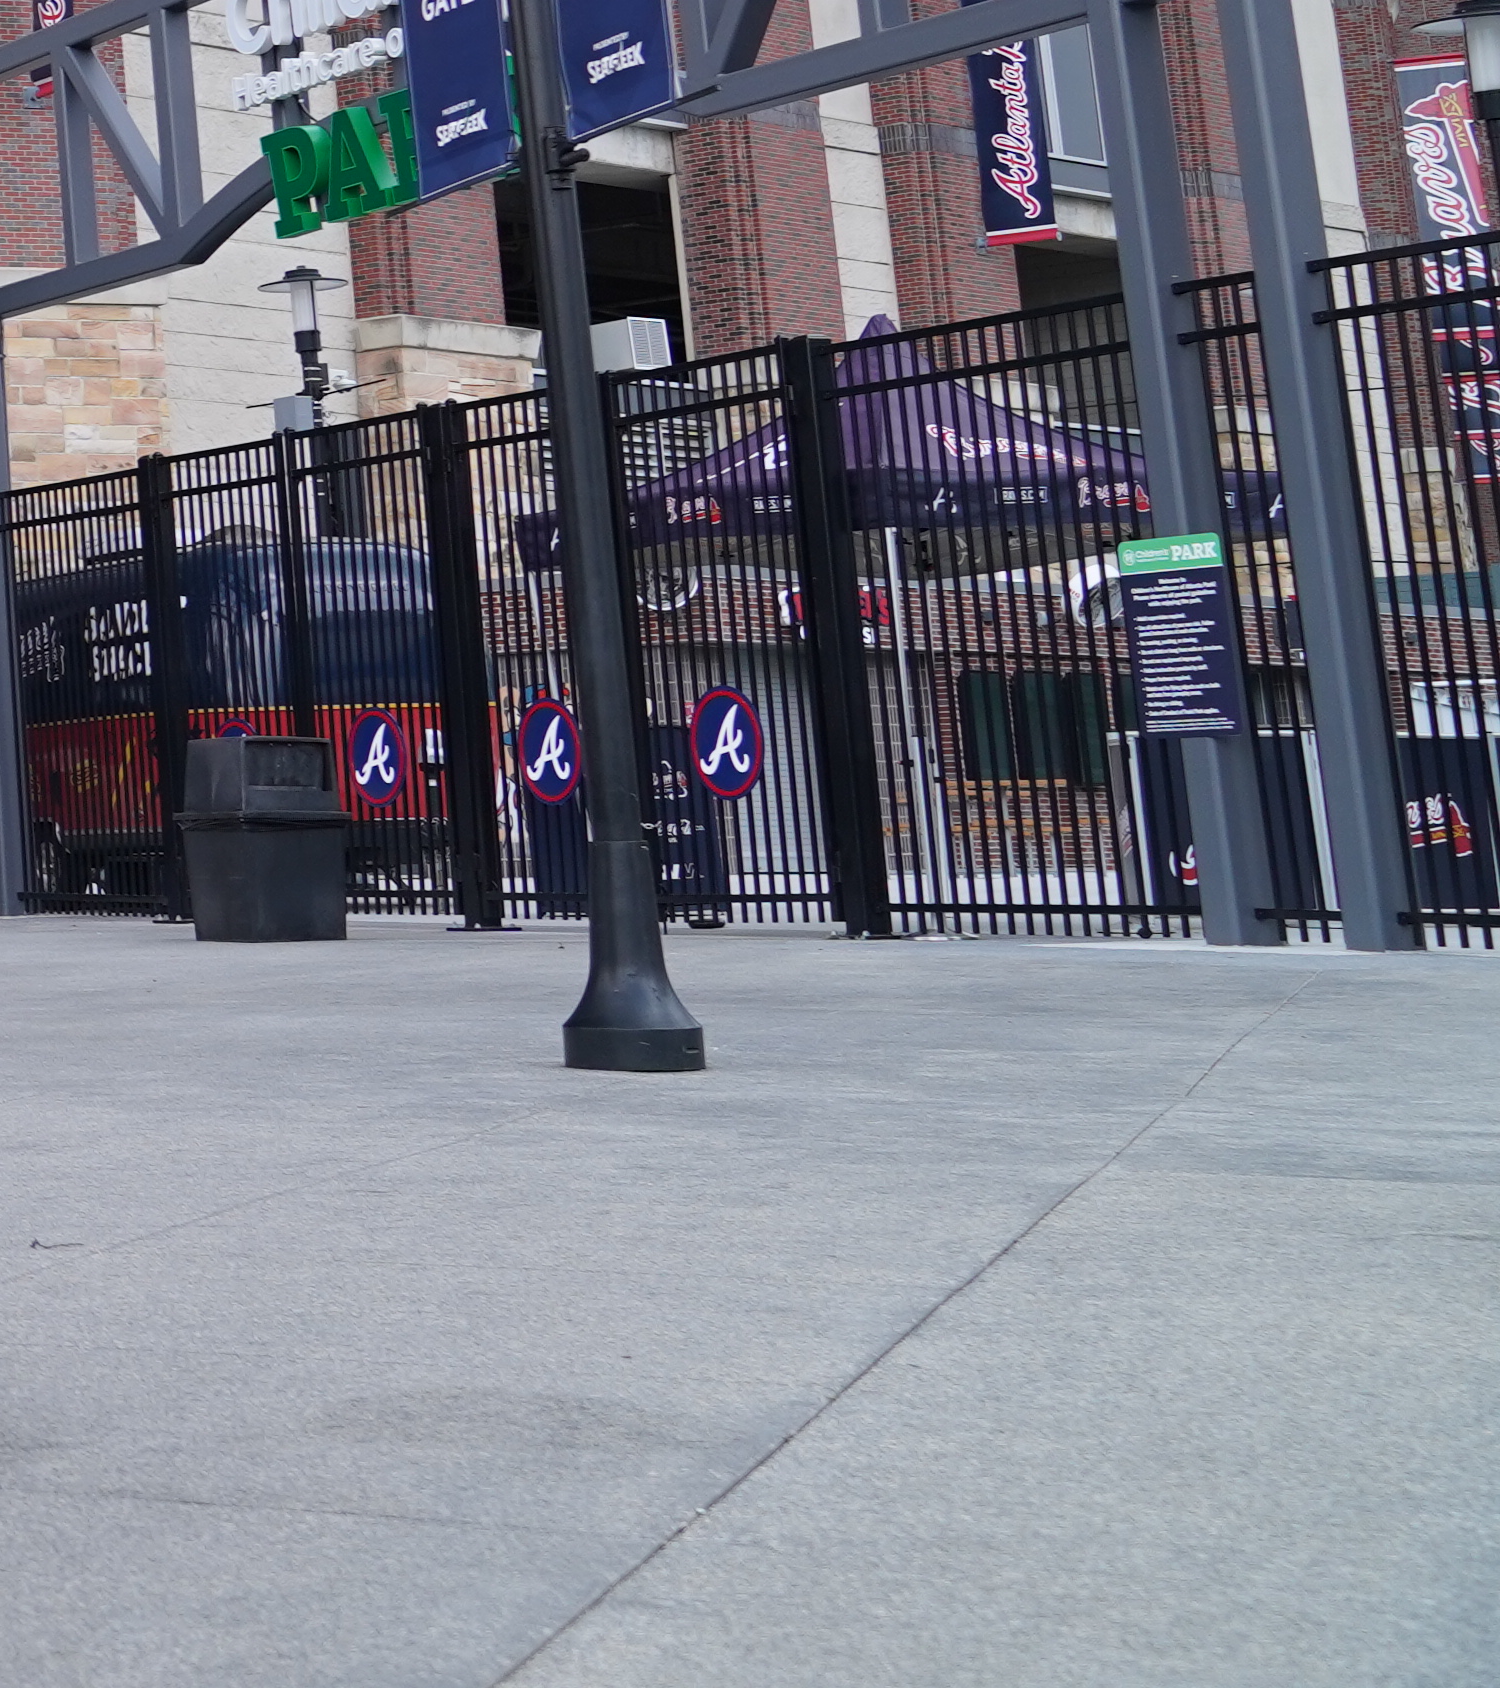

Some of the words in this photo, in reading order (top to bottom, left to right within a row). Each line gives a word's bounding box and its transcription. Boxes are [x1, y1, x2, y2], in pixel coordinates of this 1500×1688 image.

[232, 36, 387, 112] Healthcare
[385, 27, 404, 59] o
[989, 61, 1041, 219] Atlanta
[1170, 542, 1218, 561] PARK
